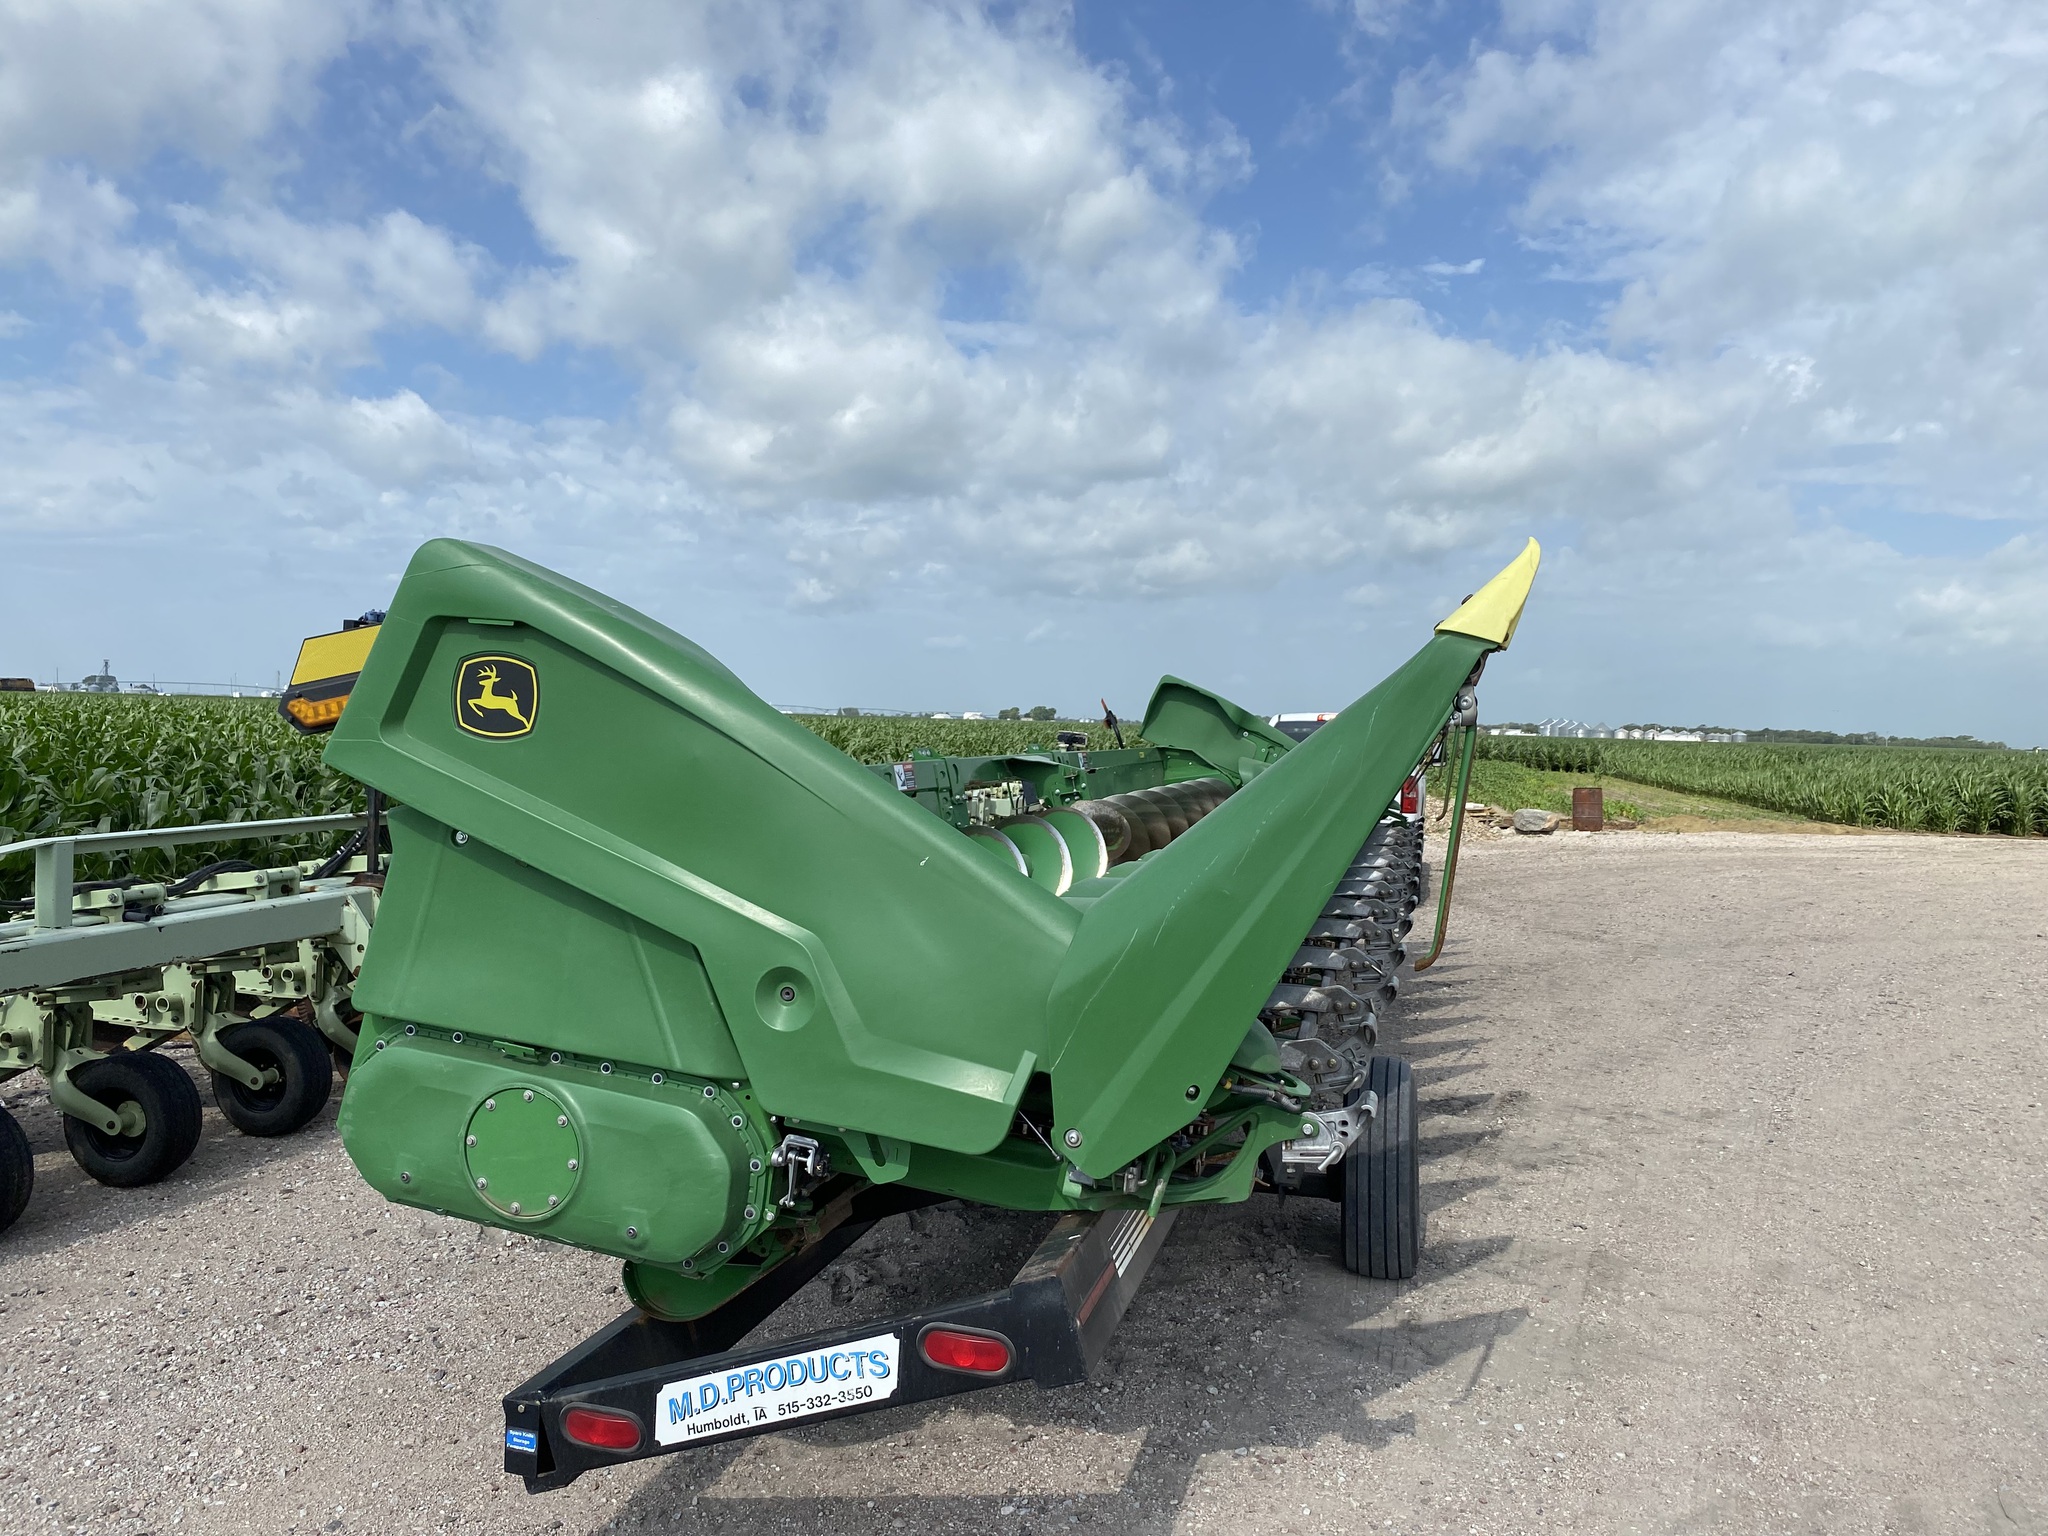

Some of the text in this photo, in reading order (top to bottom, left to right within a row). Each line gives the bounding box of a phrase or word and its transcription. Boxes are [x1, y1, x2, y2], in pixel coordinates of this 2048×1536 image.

[668, 1349, 890, 1425] M.D.PRODUCTS
[687, 1385, 873, 1436] Humboldt, IA 515-332-3550
